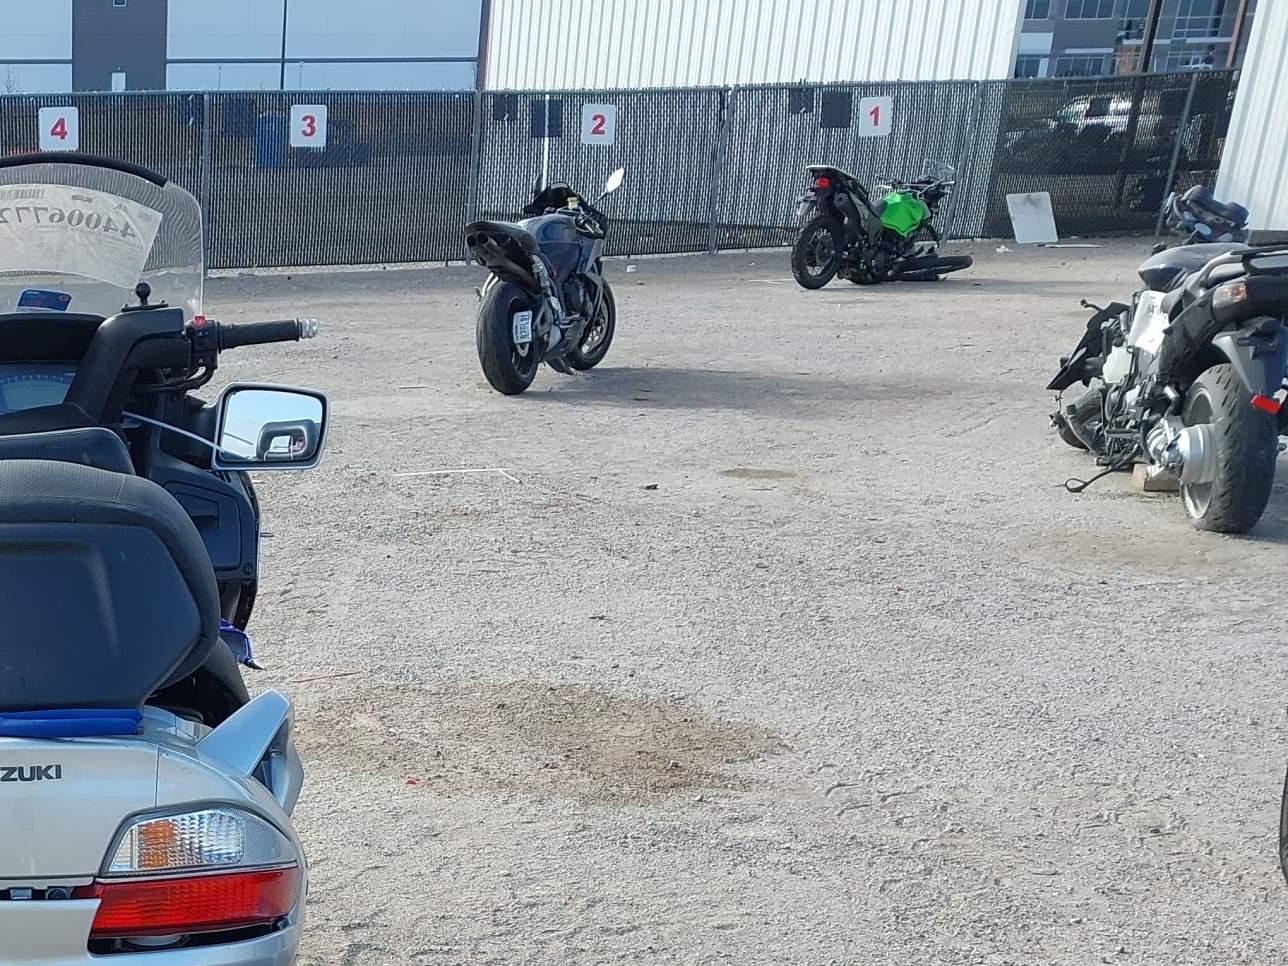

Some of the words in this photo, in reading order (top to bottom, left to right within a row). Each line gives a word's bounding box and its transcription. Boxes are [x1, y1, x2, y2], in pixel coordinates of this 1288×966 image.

[301, 115, 316, 137] 3
[592, 114, 605, 135] 2
[870, 106, 882, 127] 1
[50, 118, 68, 140] 4
